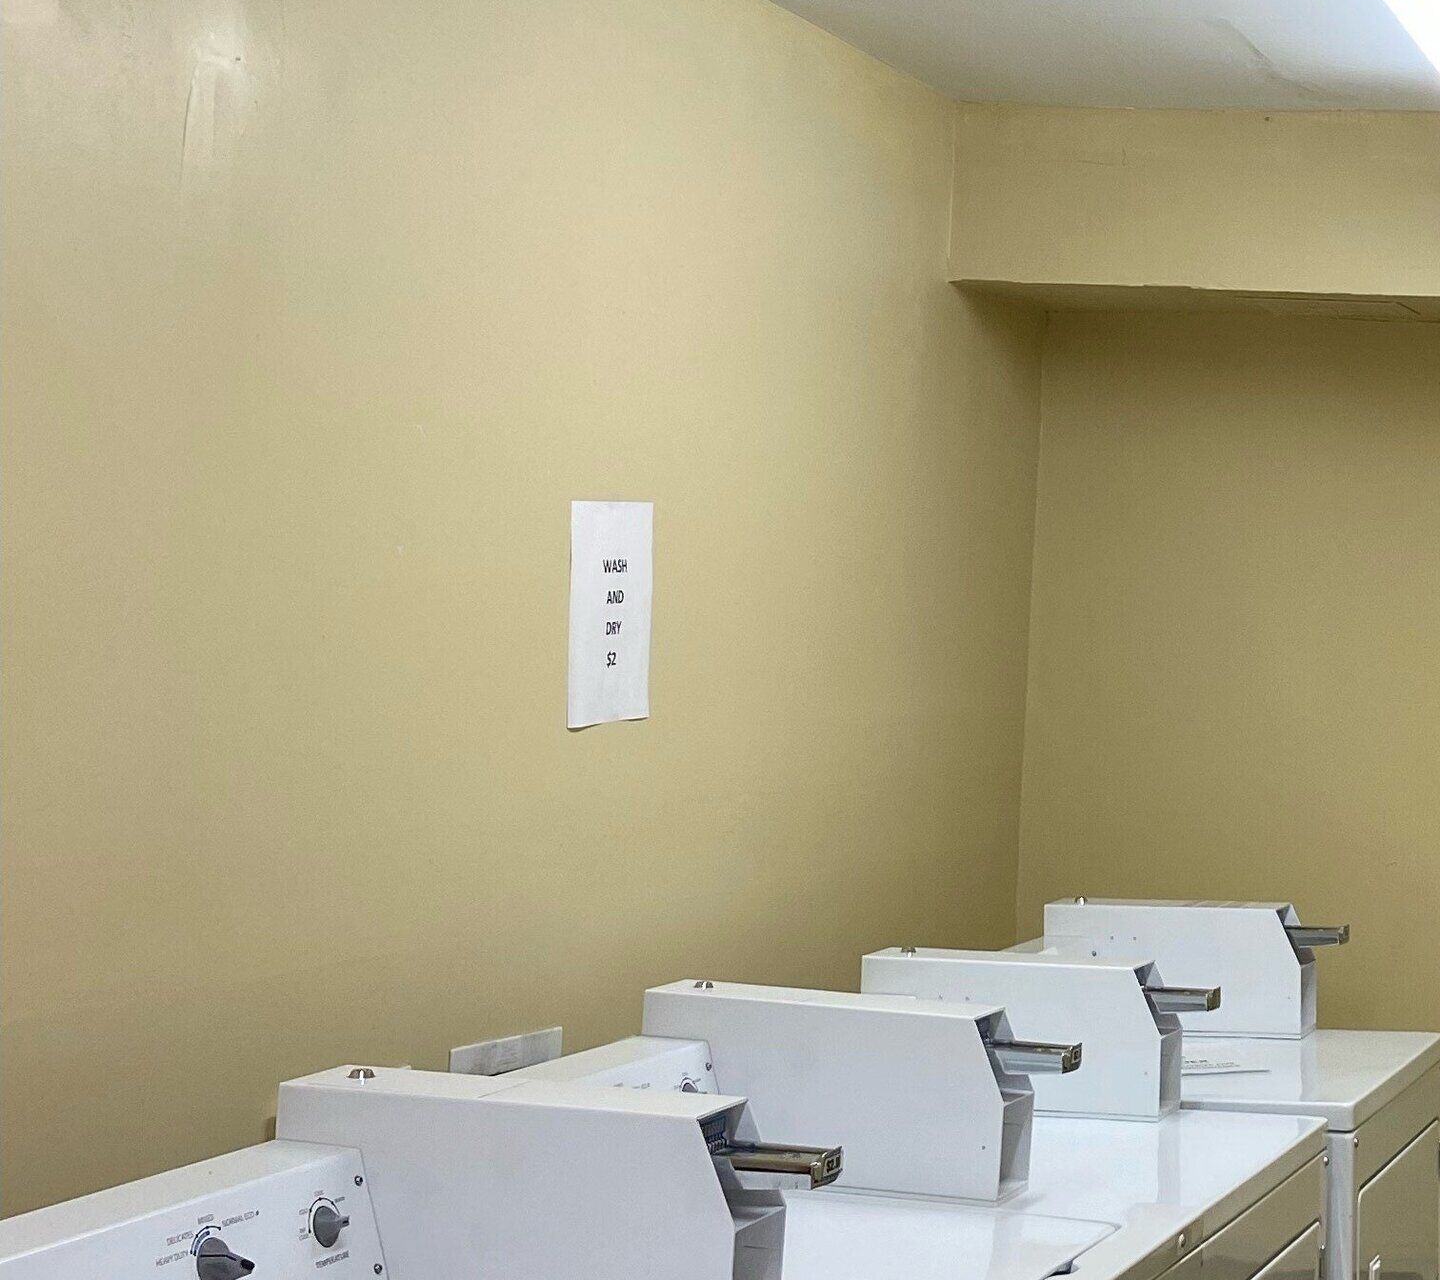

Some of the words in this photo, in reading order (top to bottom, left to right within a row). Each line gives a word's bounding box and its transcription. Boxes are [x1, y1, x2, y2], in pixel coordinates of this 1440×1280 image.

[602, 558, 628, 574] WASH
[606, 589, 625, 605] AND
[605, 621, 622, 636] DRY
[606, 651, 617, 668] $2
